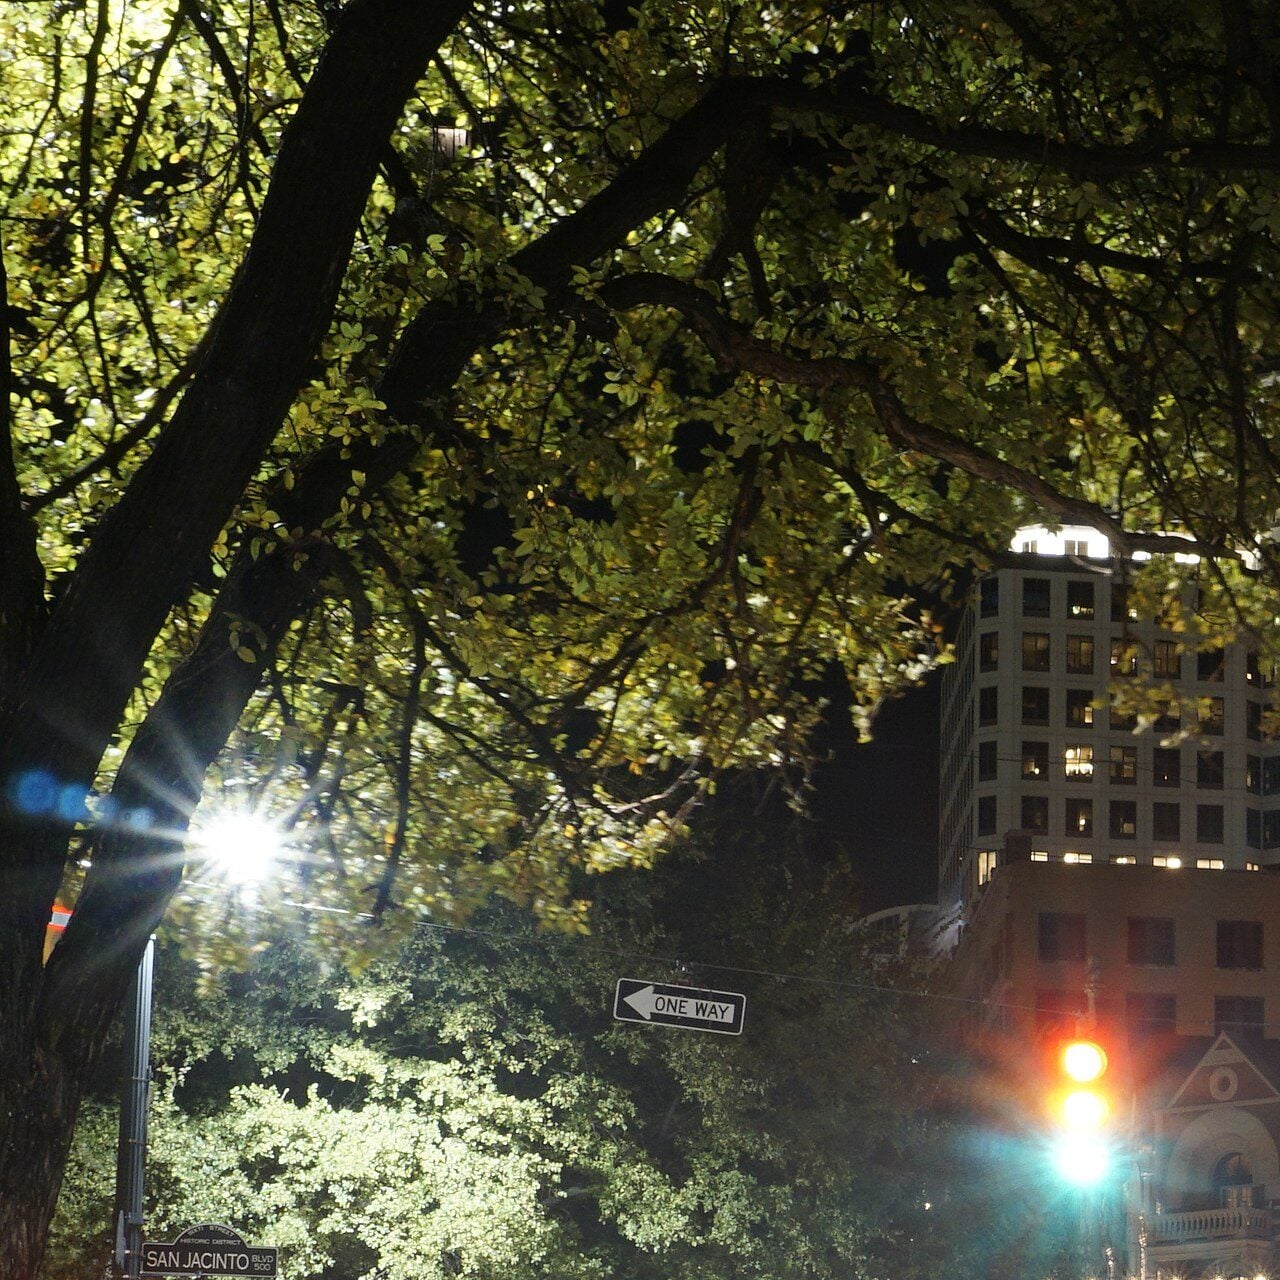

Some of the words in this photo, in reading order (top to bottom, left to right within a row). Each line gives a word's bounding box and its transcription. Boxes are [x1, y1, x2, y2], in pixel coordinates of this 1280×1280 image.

[655, 996, 688, 1015] ONE
[695, 1001, 729, 1019] WAY
[146, 1250, 179, 1268] SAN
[182, 1252, 249, 1271] JACINTO
[251, 1254, 273, 1263] BLVD
[254, 1263, 271, 1271] 500
